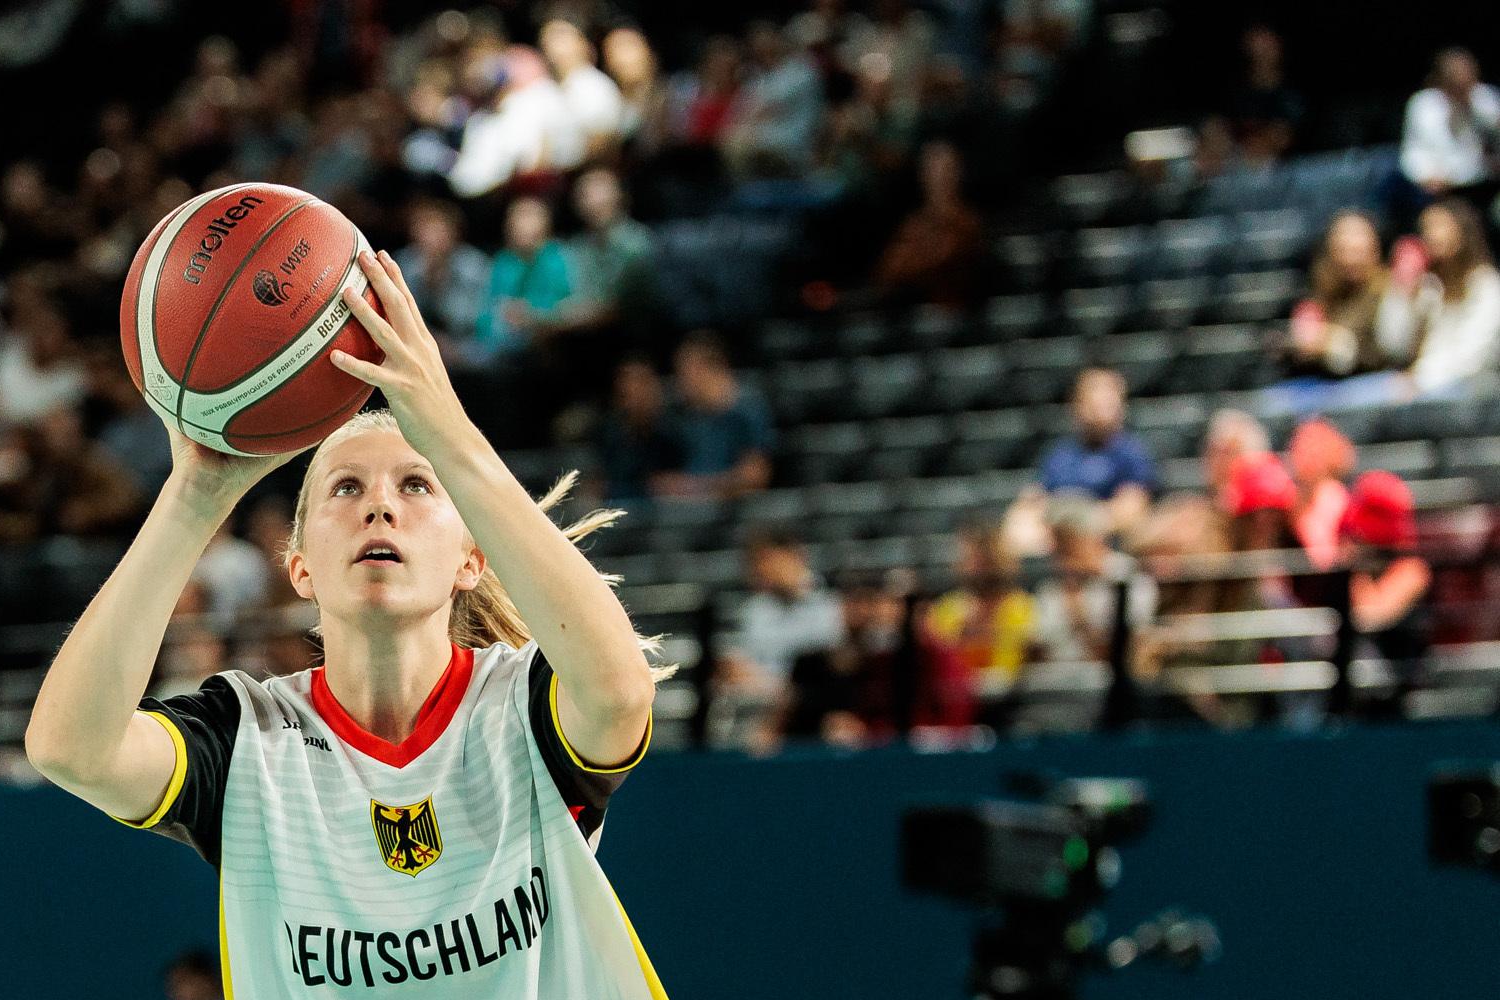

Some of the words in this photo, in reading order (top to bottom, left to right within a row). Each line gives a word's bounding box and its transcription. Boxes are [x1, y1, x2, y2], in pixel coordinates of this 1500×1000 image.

[183, 196, 265, 285] molten
[214, 380, 269, 412] PARALYMPIQUES
[267, 373, 278, 382] DE
[276, 357, 297, 375] PARIS
[295, 342, 313, 359] 2024
